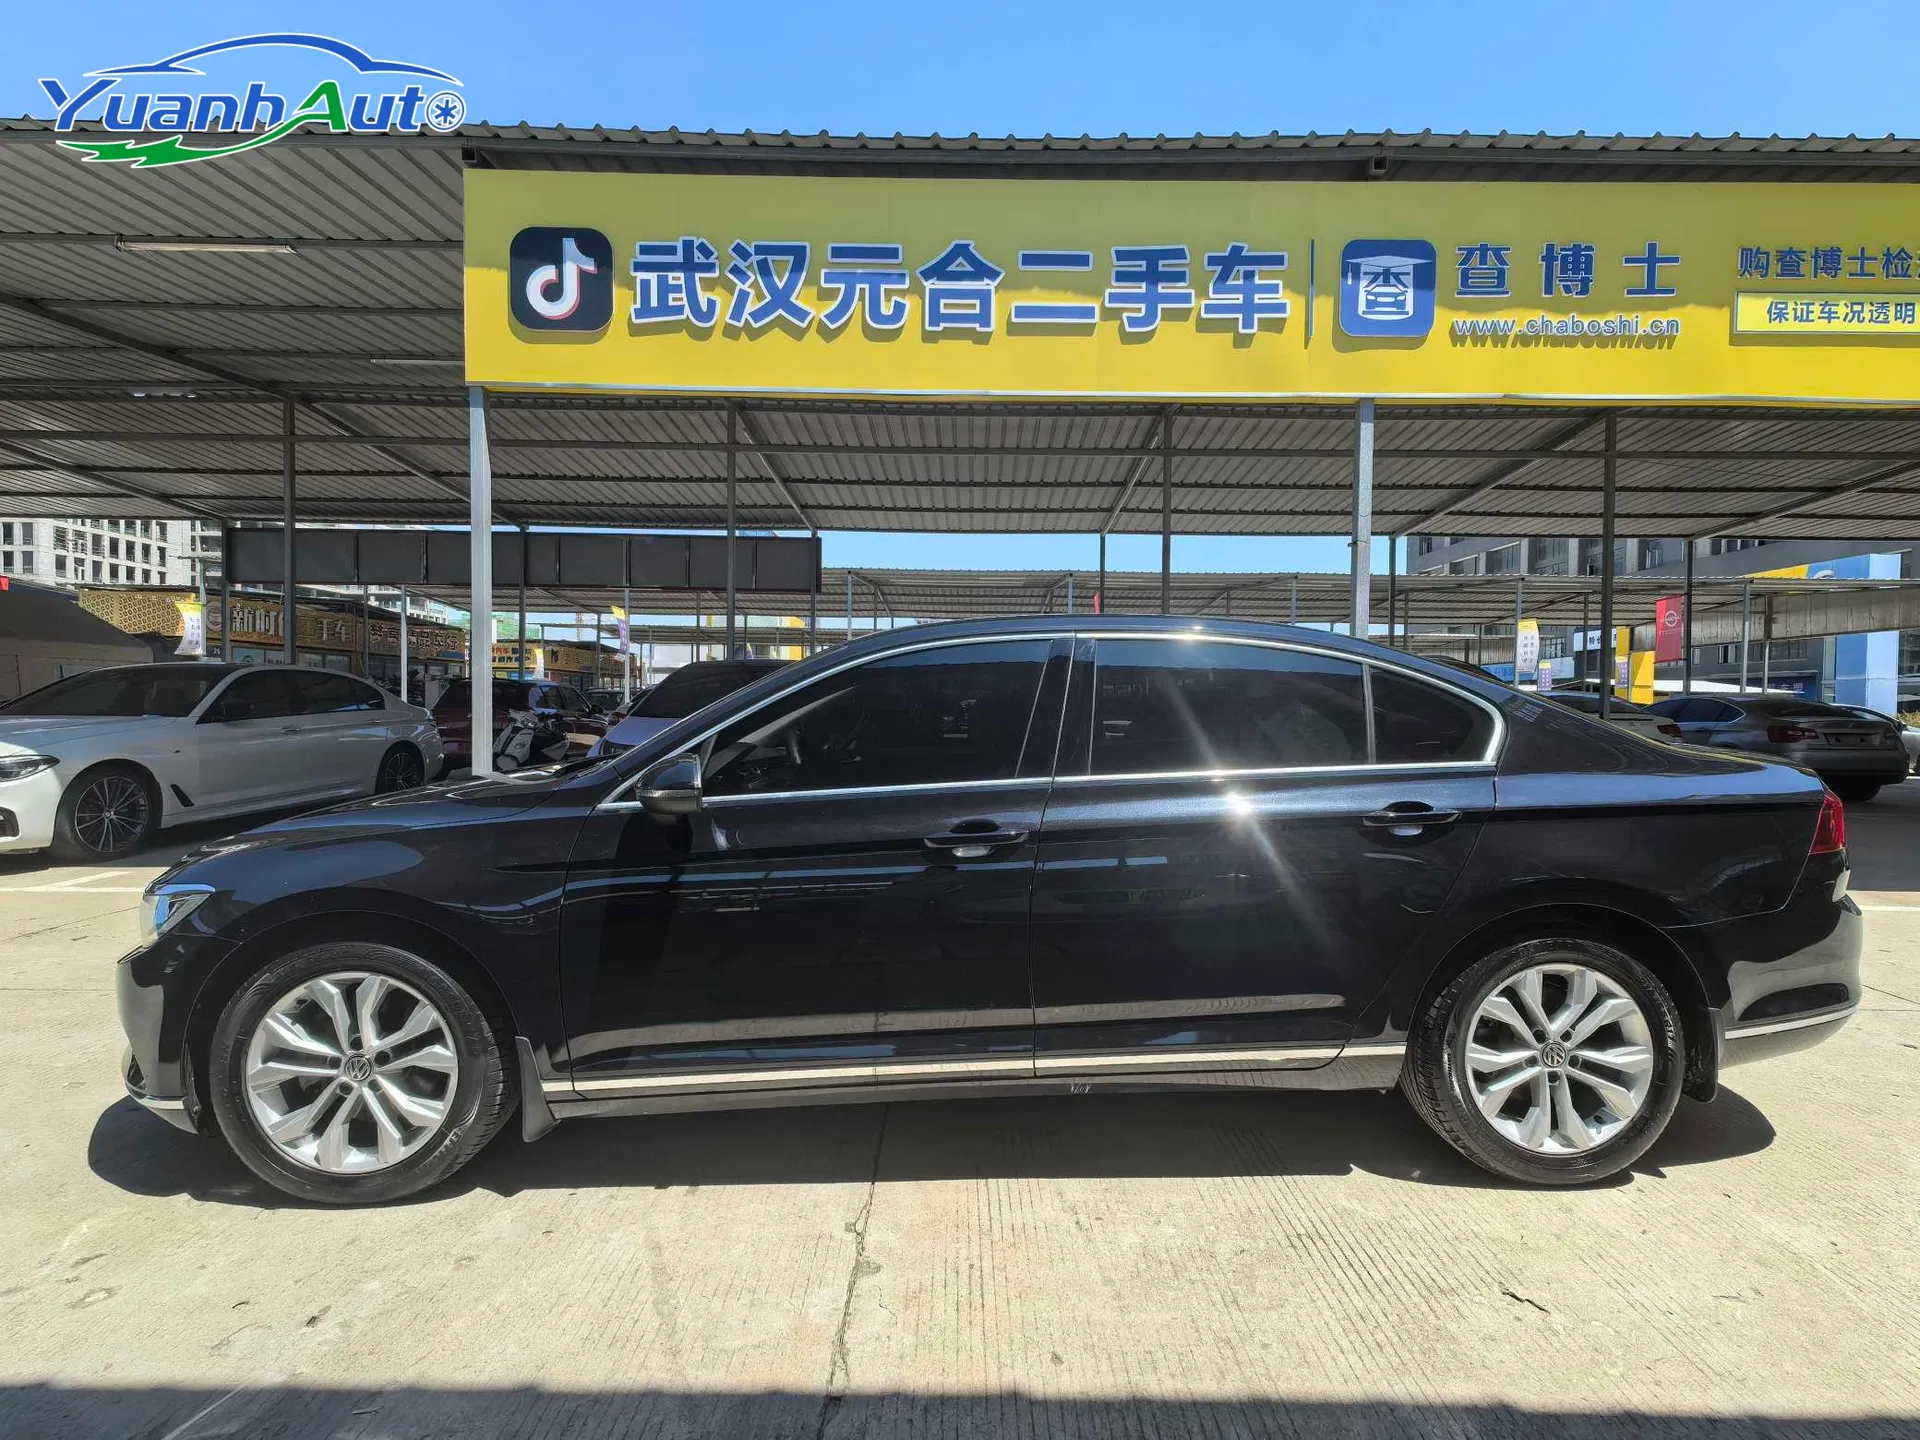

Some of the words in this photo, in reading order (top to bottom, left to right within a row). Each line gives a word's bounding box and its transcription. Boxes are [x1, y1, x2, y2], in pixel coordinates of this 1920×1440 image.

[1454, 241, 1681, 297] 查博士
[1738, 246, 1920, 280] 购查博士检
[629, 236, 1291, 334] 武汉元合二手车
[1454, 314, 1681, 336] www.chaboshi.cn
[1767, 300, 1916, 324] 保证车况透明
